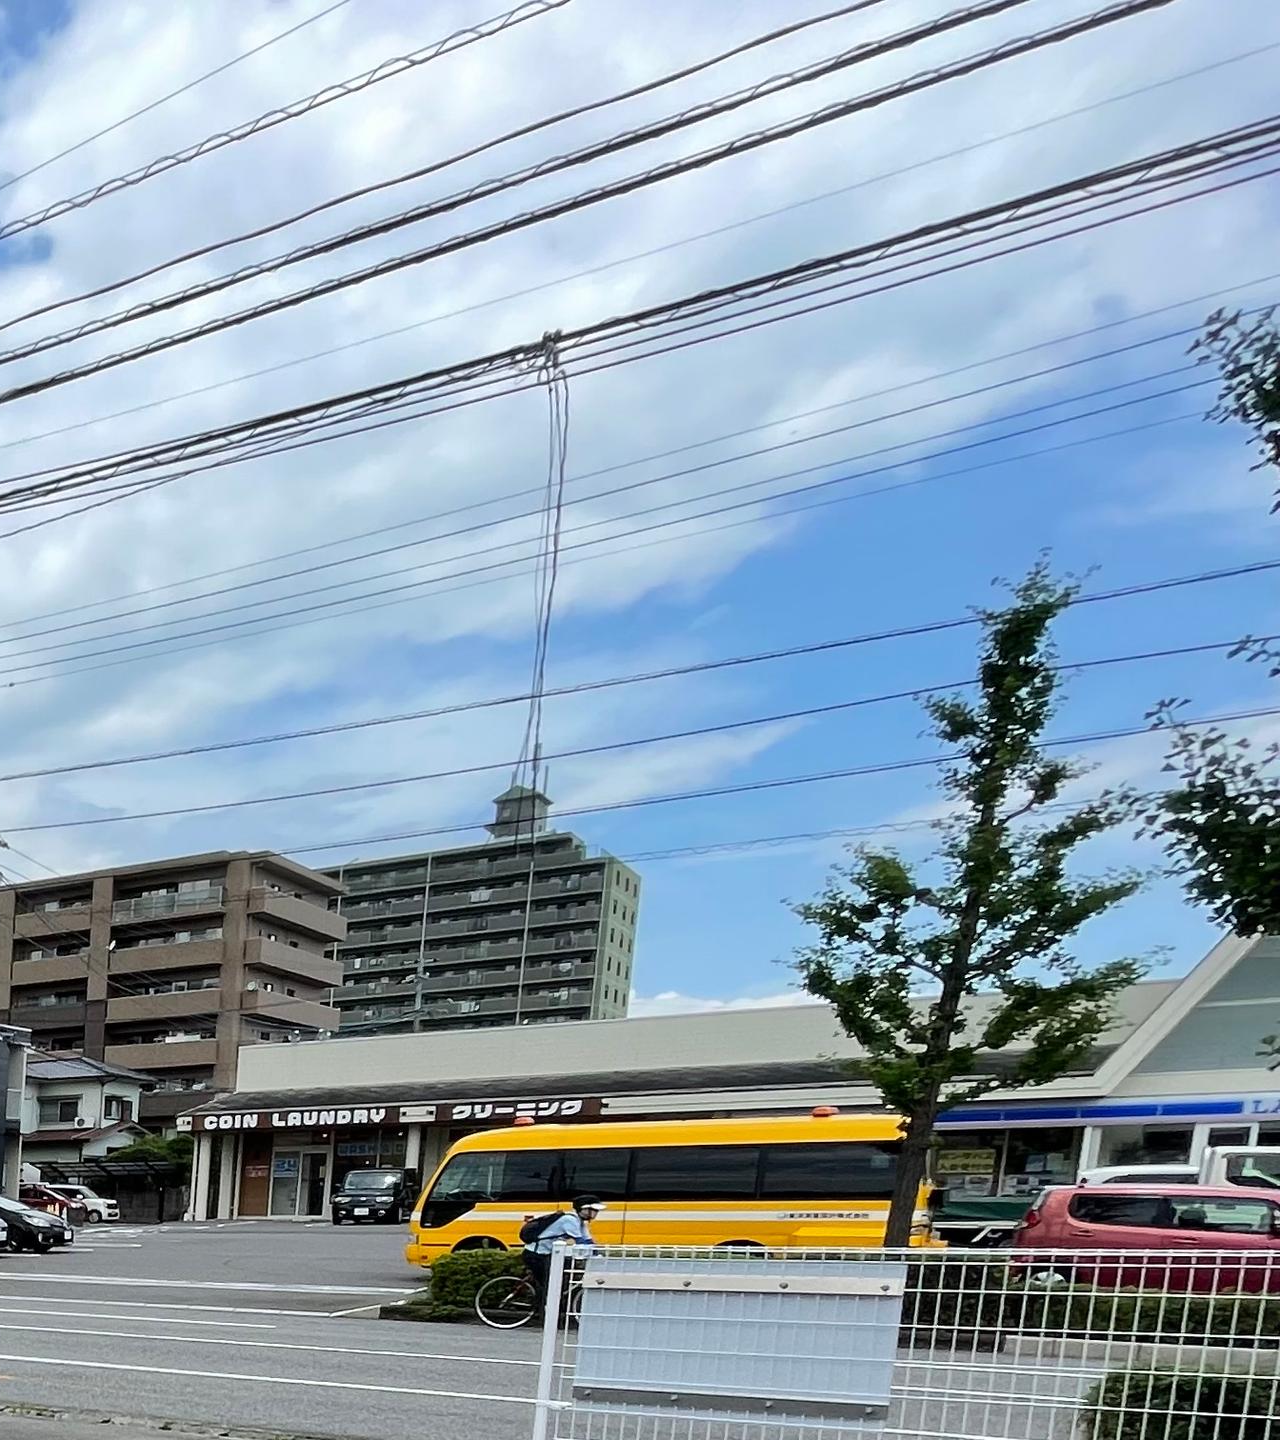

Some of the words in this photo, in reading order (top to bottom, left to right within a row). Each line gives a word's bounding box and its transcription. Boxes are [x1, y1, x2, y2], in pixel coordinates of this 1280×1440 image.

[204, 1113, 259, 1131] COIN
[271, 1108, 386, 1128] LAUNDRY
[452, 1100, 583, 1120] クリーニング
